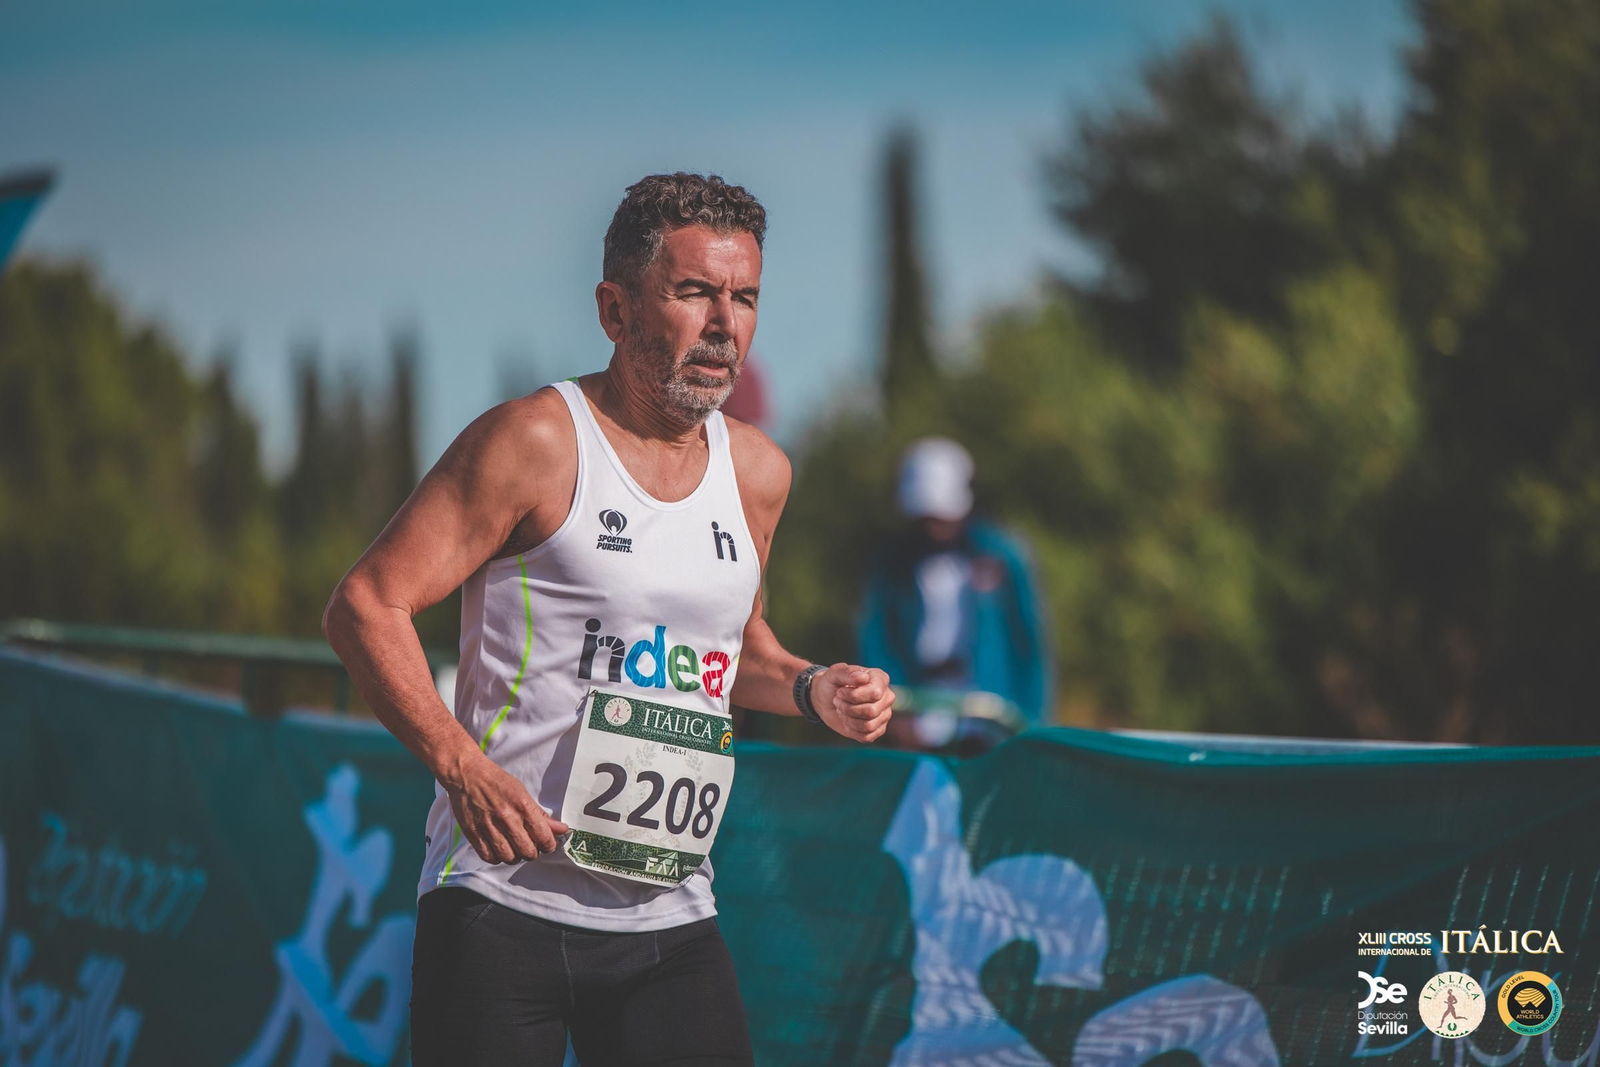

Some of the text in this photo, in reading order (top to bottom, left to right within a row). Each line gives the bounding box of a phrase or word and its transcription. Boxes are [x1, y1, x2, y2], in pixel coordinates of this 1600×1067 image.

[596, 542, 633, 553] PURSUITS.
[598, 535, 632, 546] SPORTING
[577, 618, 731, 698] indea
[643, 708, 712, 739] ITÁLICA
[583, 762, 720, 840] 2208
